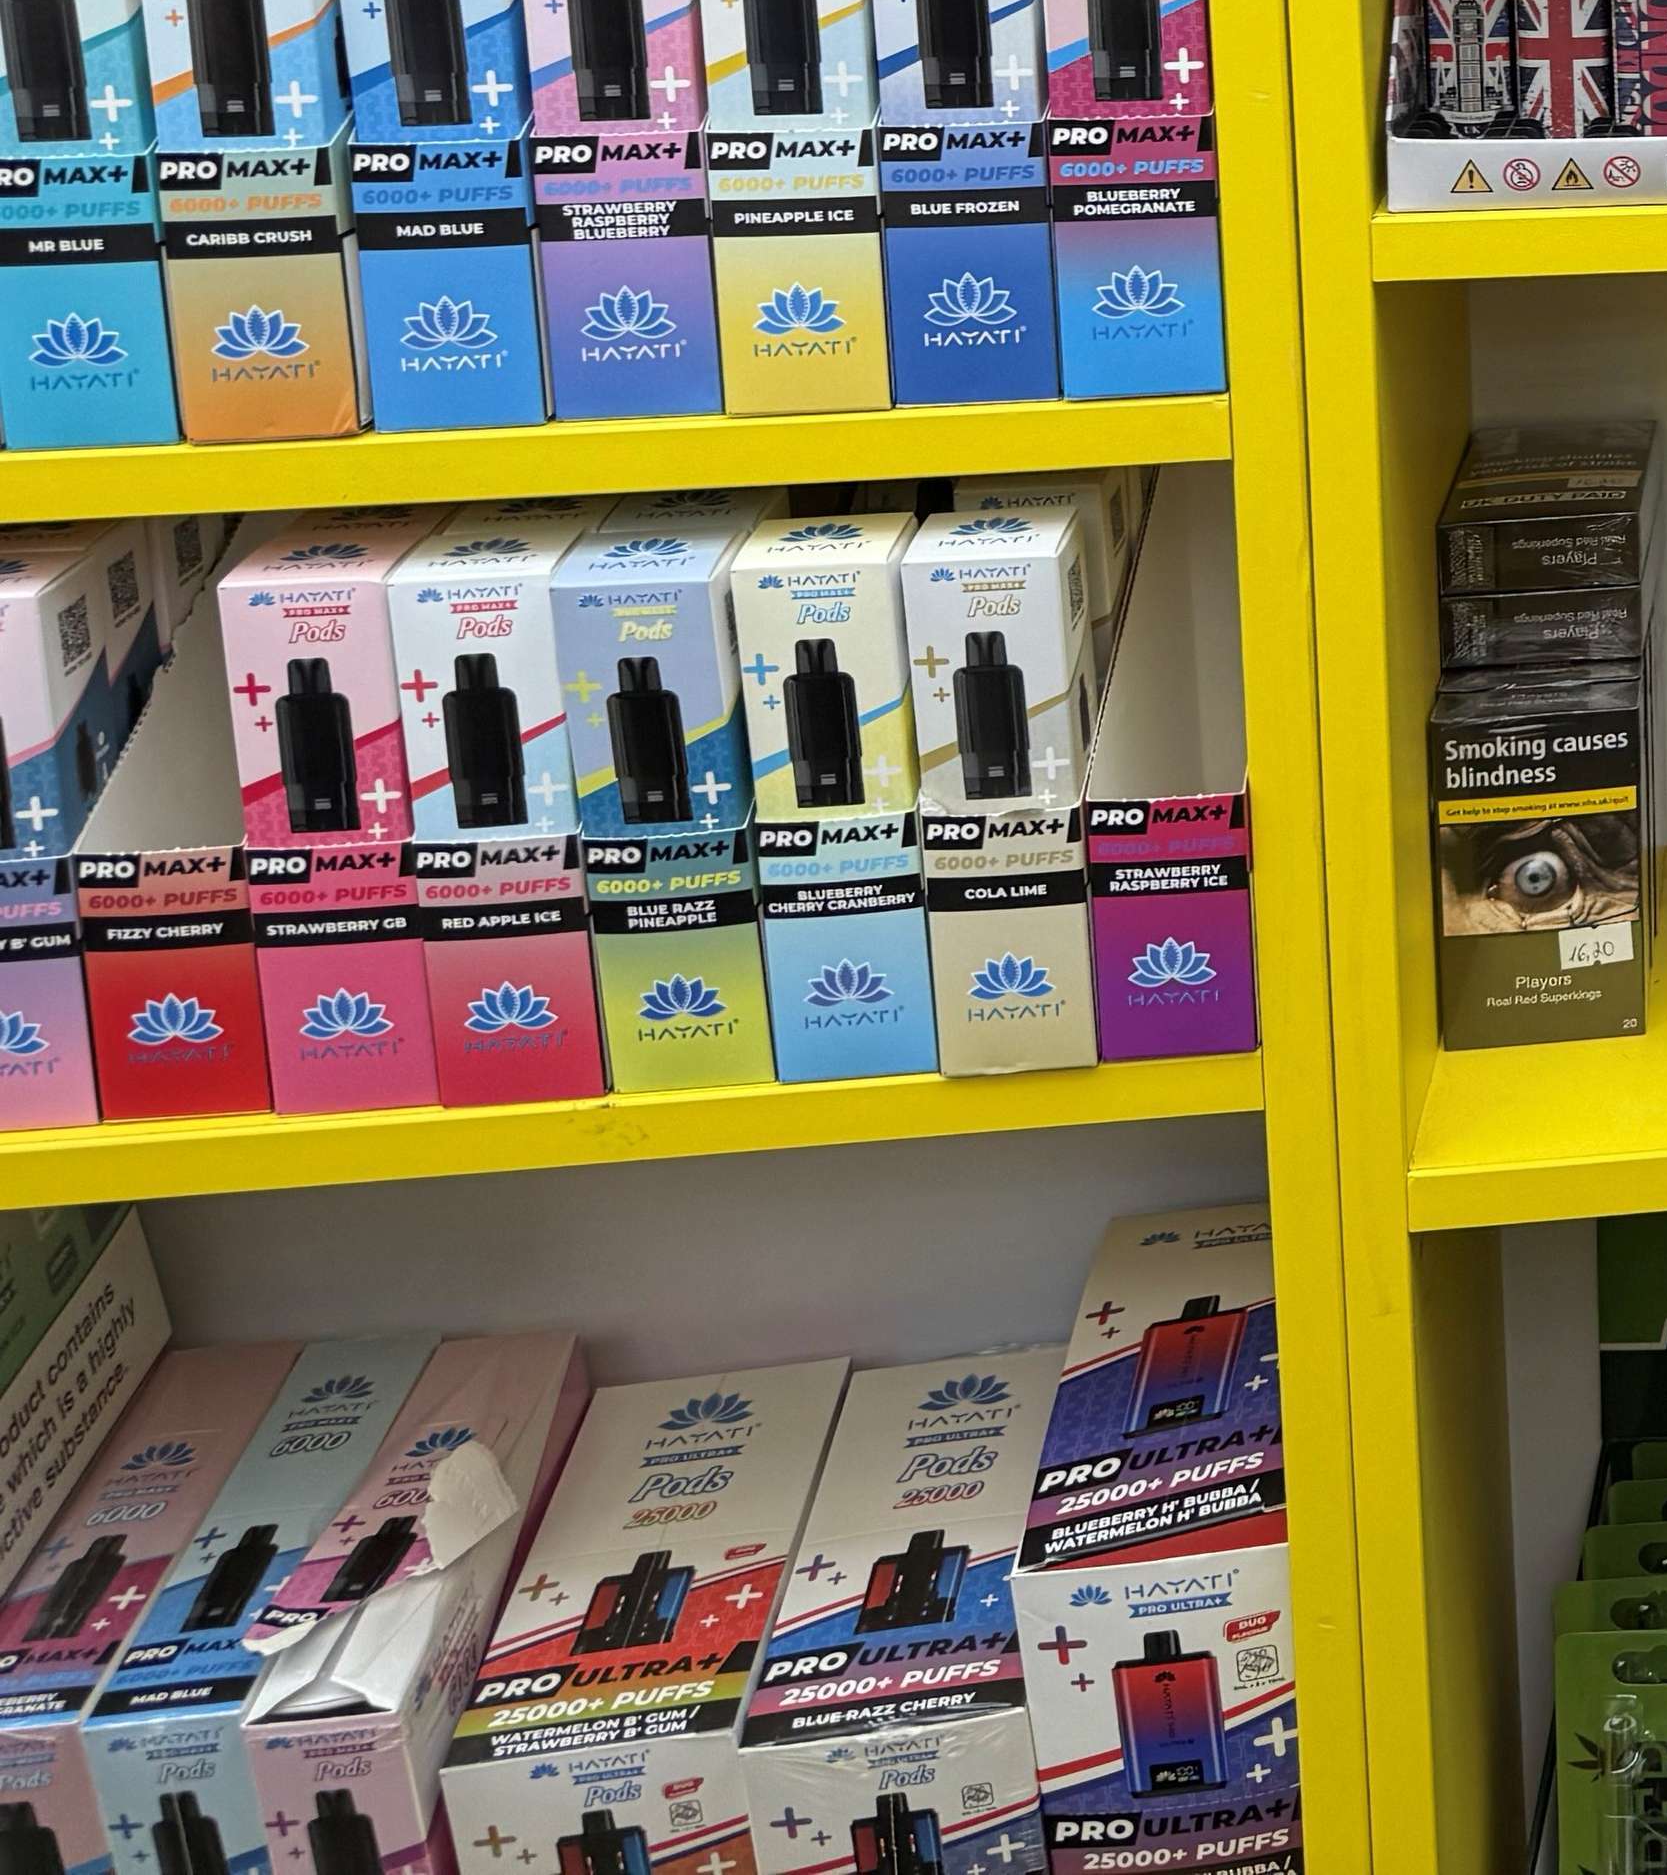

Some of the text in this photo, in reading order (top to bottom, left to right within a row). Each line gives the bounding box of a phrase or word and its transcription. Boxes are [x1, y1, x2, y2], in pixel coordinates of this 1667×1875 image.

[1086, 188, 1181, 203] BLUEBERRY
[734, 208, 854, 224] PINEAPPLE ICE
[911, 200, 1020, 215] BLUE FROZEN
[1073, 200, 1195, 216] POMEGRANATE
[186, 229, 312, 246] CARIBB CRUSH
[1444, 730, 1629, 766] Smoking causes
[1445, 764, 1557, 790] blindness
[965, 884, 1047, 900] COLA LIME
[442, 910, 561, 929] RED APPLE ICE
[1038, 1455, 1122, 1493] PRO
[1056, 1452, 1264, 1515] 25000+ PUFFS
[793, 1691, 975, 1730] BLUE RAZZ CHERRY
